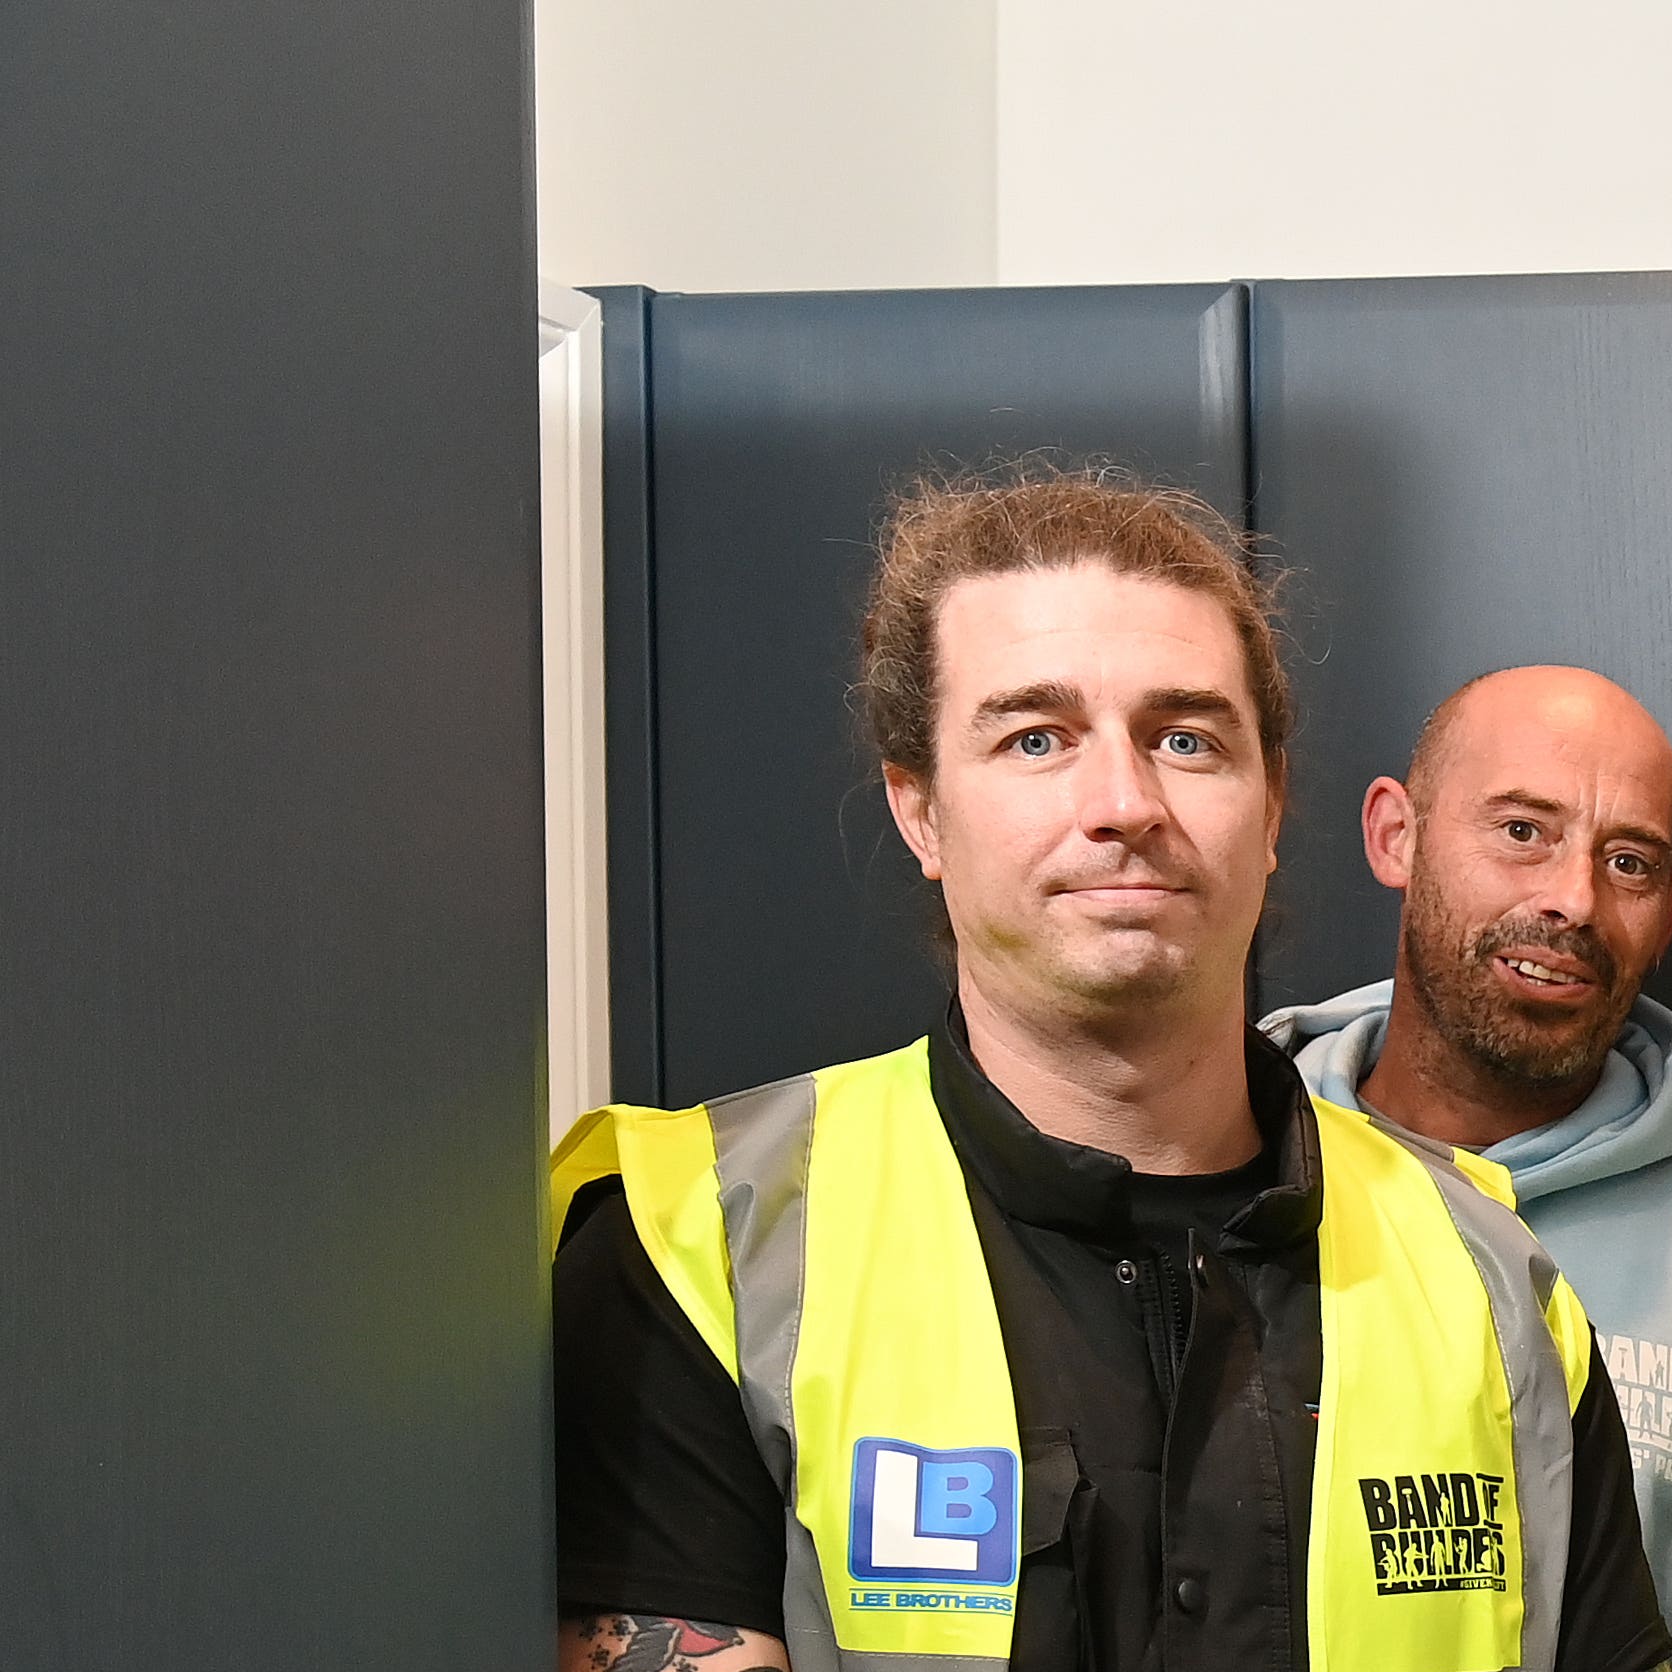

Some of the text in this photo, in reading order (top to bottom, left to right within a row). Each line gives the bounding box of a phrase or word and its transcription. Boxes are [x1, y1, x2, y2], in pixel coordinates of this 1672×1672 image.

[1358, 1473, 1480, 1532] BAND
[851, 1593, 1012, 1611] LEE BROTHERS
